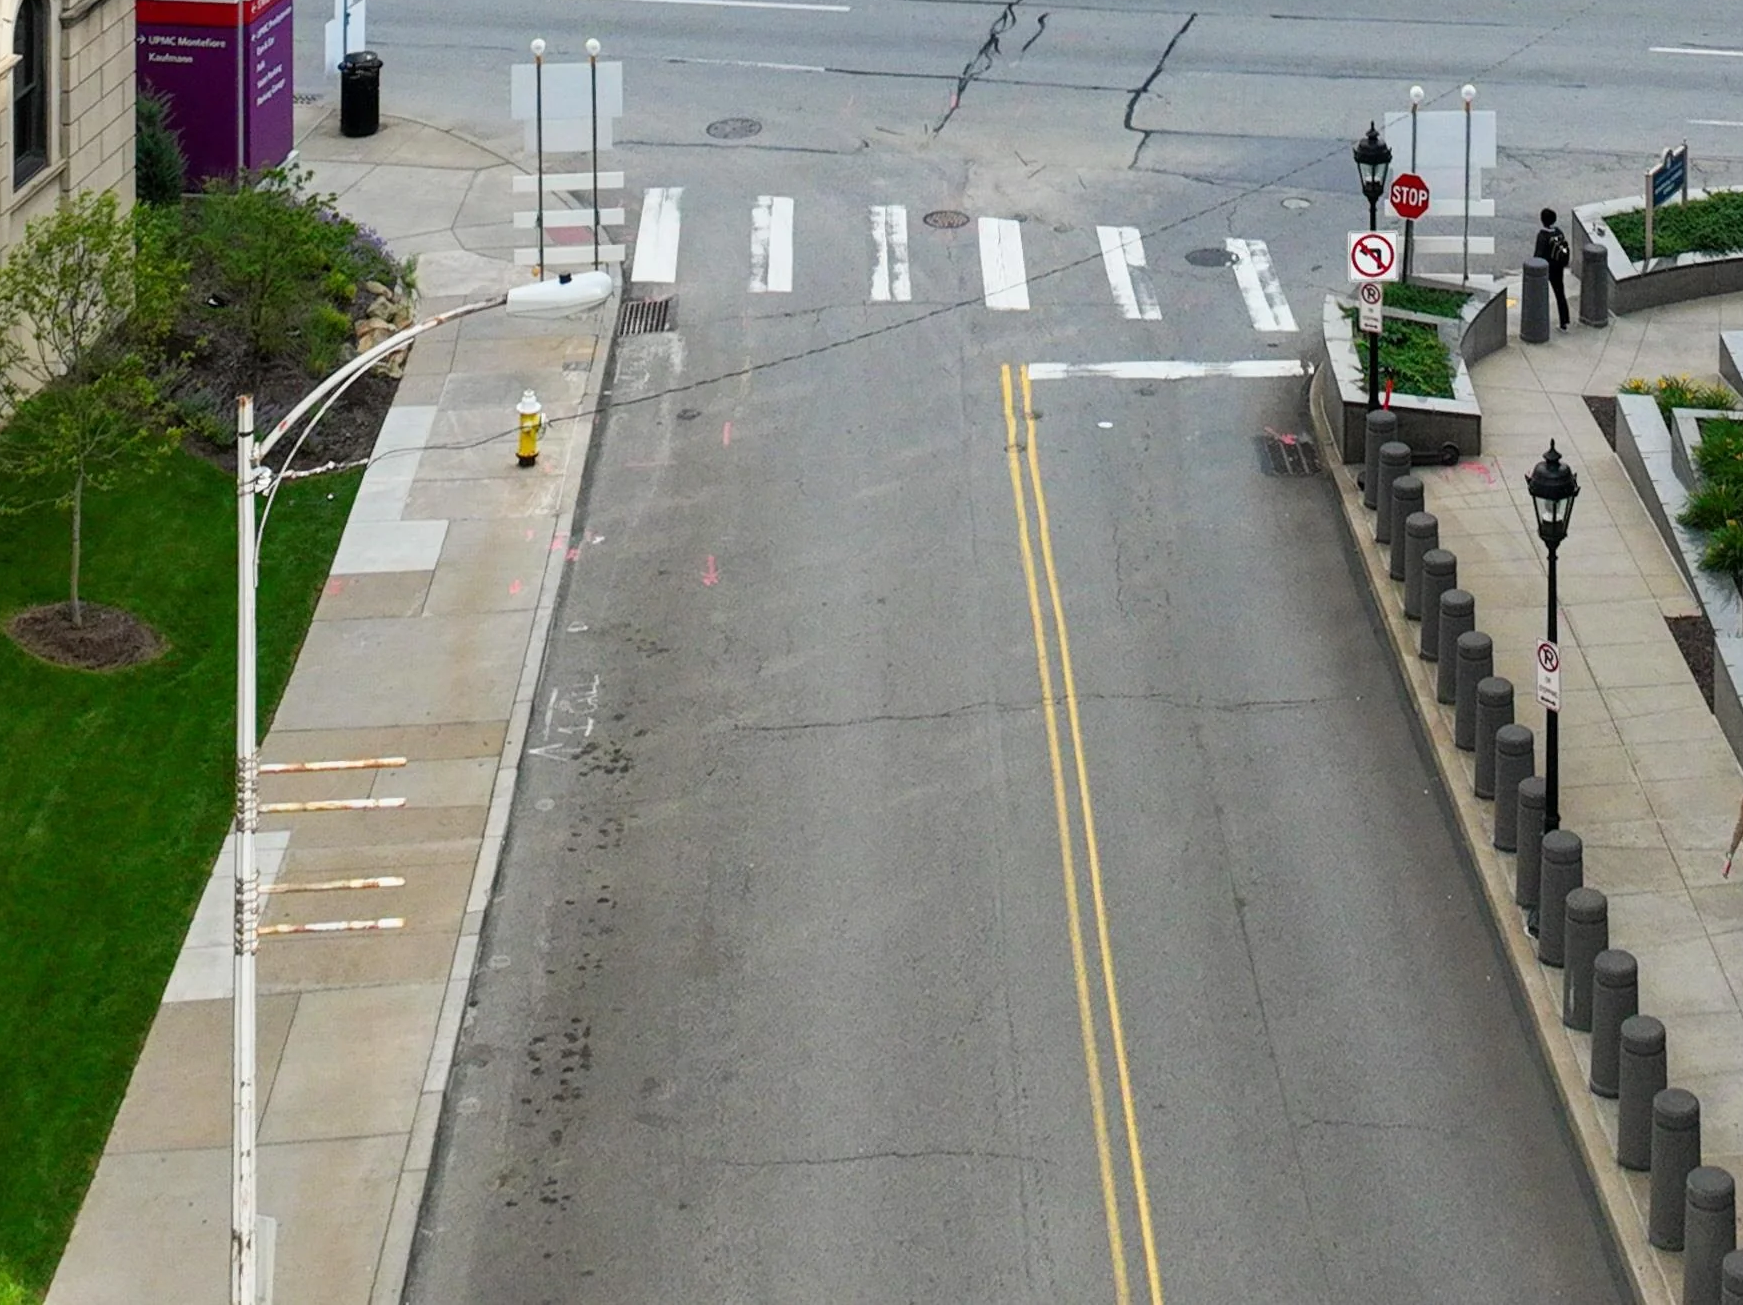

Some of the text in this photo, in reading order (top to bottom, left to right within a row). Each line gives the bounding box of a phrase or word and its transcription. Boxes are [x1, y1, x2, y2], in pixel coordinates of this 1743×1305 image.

[148, 35, 226, 49] UPMC Montefiore
[148, 52, 194, 64] Kaufmann
[1391, 186, 1428, 207] STOP
